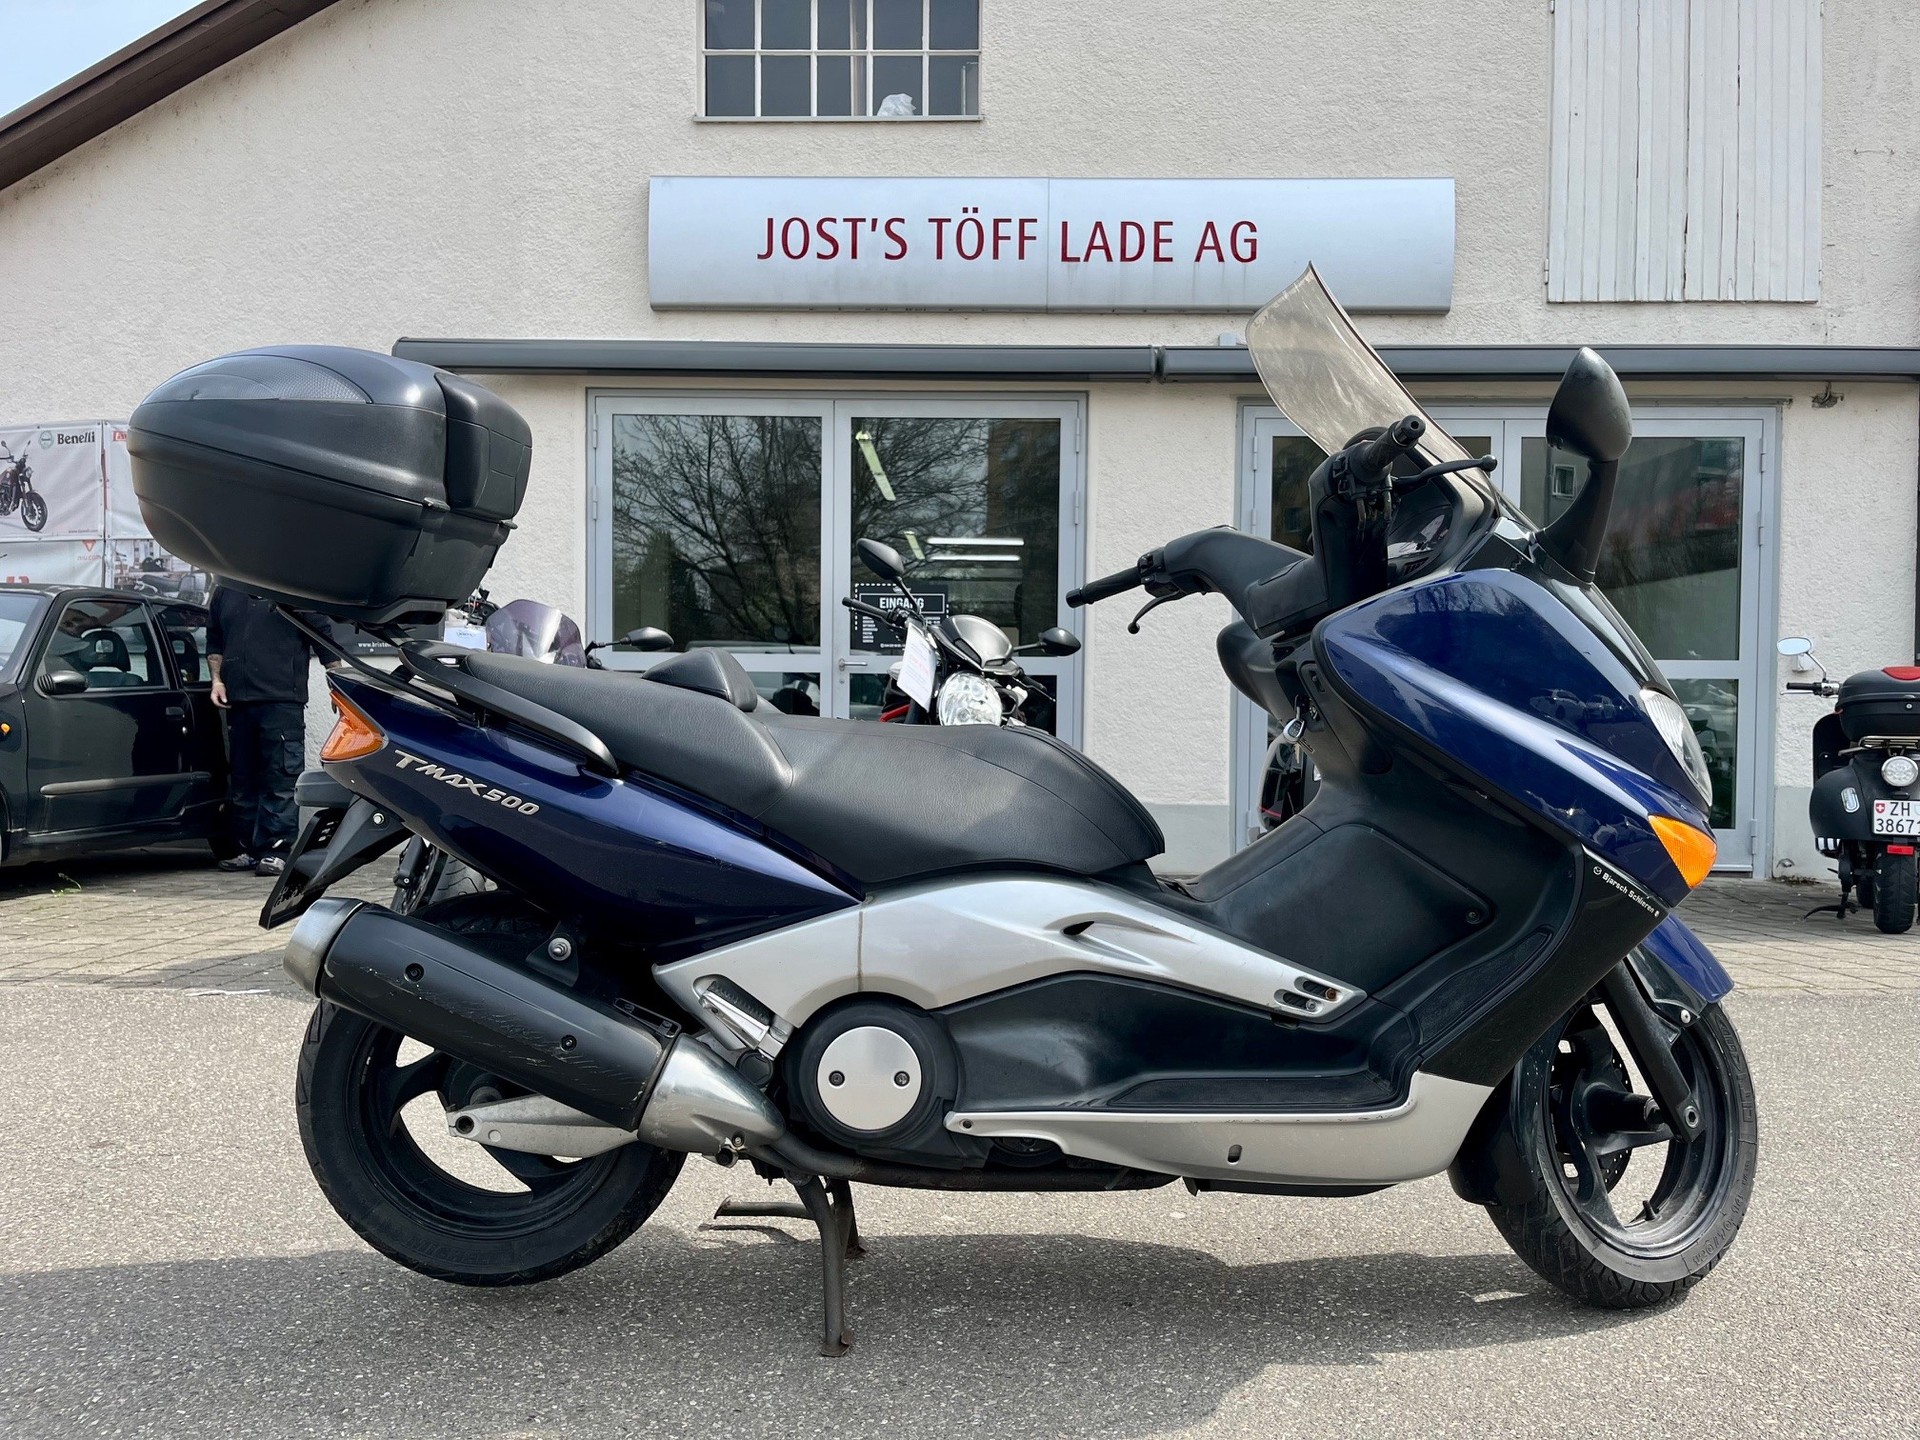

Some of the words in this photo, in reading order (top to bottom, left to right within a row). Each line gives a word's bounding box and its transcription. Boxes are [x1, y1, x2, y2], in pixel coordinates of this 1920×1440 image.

[757, 217, 908, 260] JOST'S
[928, 207, 1038, 260] TÖFF
[1061, 221, 1174, 263] LADE
[1194, 221, 1258, 263] AG
[57, 431, 95, 445] Benelli
[1890, 801, 1910, 816] ZH
